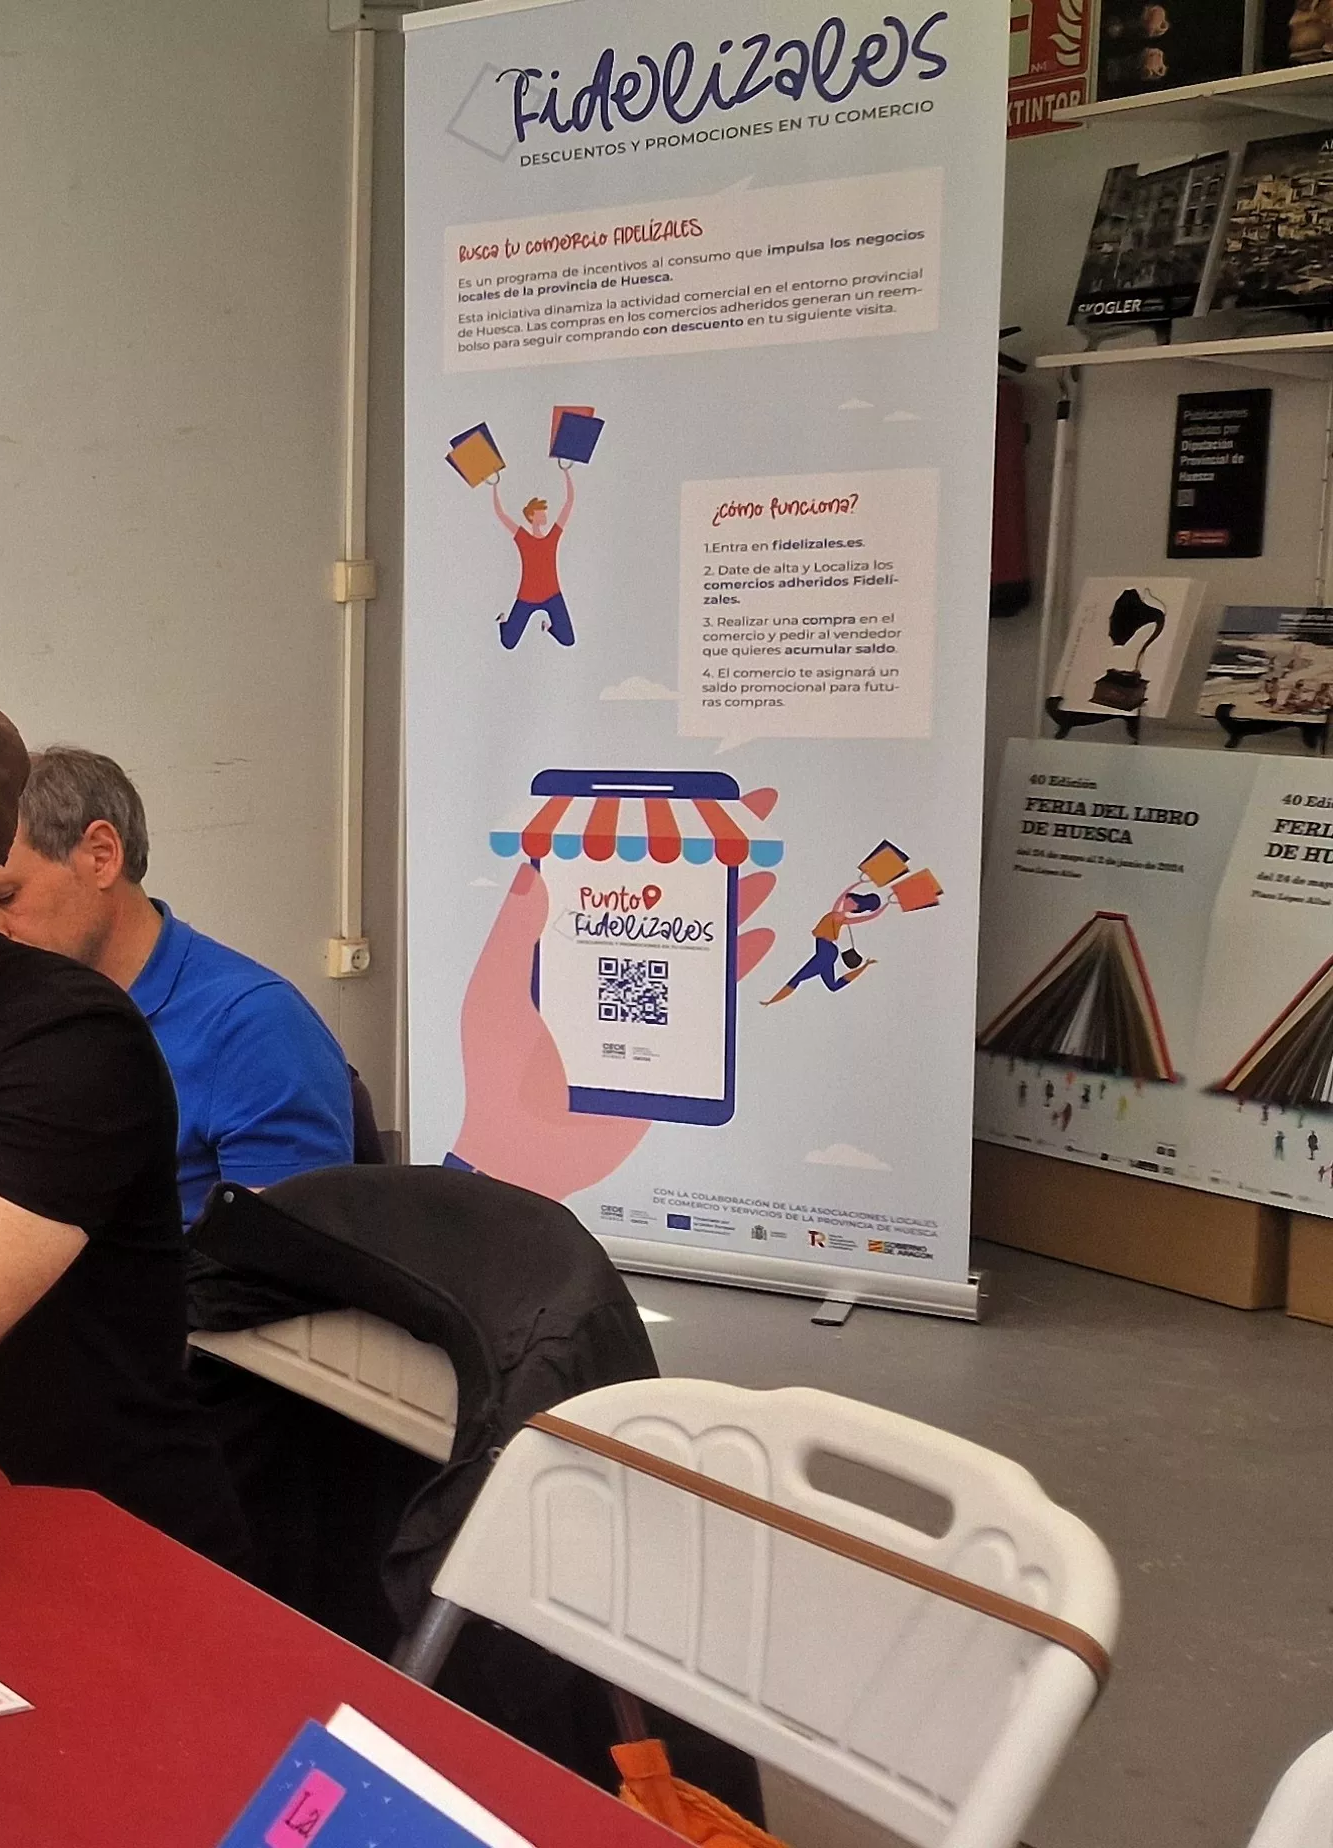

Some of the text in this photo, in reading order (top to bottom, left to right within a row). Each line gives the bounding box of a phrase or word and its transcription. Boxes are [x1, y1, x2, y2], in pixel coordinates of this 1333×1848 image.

[520, 99, 934, 167] DESCUENTOS Y PROMOCIONES EN TU COMERCIO
[458, 230, 925, 289] Es un programa de incentivos al consumo que impulsa los negocios
[458, 289, 501, 303] locales
[503, 287, 519, 298] de
[522, 285, 534, 296] la
[536, 278, 598, 297] provincia
[600, 277, 617, 288] de
[458, 267, 923, 324] Esta iniciativa dinamiza la actividad comercial en el entorno provincial
[457, 327, 473, 338] de
[526, 321, 548, 332] Las
[549, 316, 606, 330] compras
[607, 314, 625, 324] en
[627, 311, 646, 322] los
[648, 304, 717, 320] comercios
[719, 297, 789, 314] adheridos
[791, 292, 851, 309] generan
[854, 290, 874, 301] un
[877, 286, 922, 298] reem-
[457, 340, 490, 352] bolso
[493, 338, 520, 351] para
[522, 333, 562, 347] seguir
[565, 326, 640, 343] comprando
[642, 325, 668, 335] con
[670, 317, 744, 333] descuento
[746, 316, 765, 326] en
[768, 314, 783, 324] tu
[786, 307, 852, 324] siguiente
[769, 493, 859, 520] funciona?
[751, 542, 769, 552] en
[718, 564, 750, 576] Date
[752, 563, 771, 575] de
[773, 562, 799, 574] alta
[800, 564, 811, 575] y
[813, 560, 870, 573] Localiza
[873, 559, 894, 570] los
[703, 577, 775, 591] comercios
[777, 575, 849, 588] adheridos
[717, 615, 769, 627] Realizar
[772, 617, 799, 626] una
[801, 615, 856, 627] compra
[859, 615, 878, 624] en
[881, 612, 894, 624] el
[702, 627, 902, 643] comercio y pedir al vendedor
[702, 647, 728, 658] que
[731, 645, 781, 657] quieres
[784, 643, 852, 655] acumular
[717, 667, 730, 679] El
[732, 667, 796, 679] comercio
[799, 668, 813, 678] te
[815, 666, 876, 680] asignará
[879, 668, 899, 677] un
[701, 680, 899, 695] saldo promocional para futu-
[701, 698, 722, 707] ras
[1024, 797, 1200, 827] FERIA DEL LIBRO
[1020, 820, 1133, 844] DE HUESCA
[580, 885, 642, 913] Punto
[653, 1187, 938, 1228] CON LA COLABORACIÓN DE LAS ASOCIACIONES LOCALES
